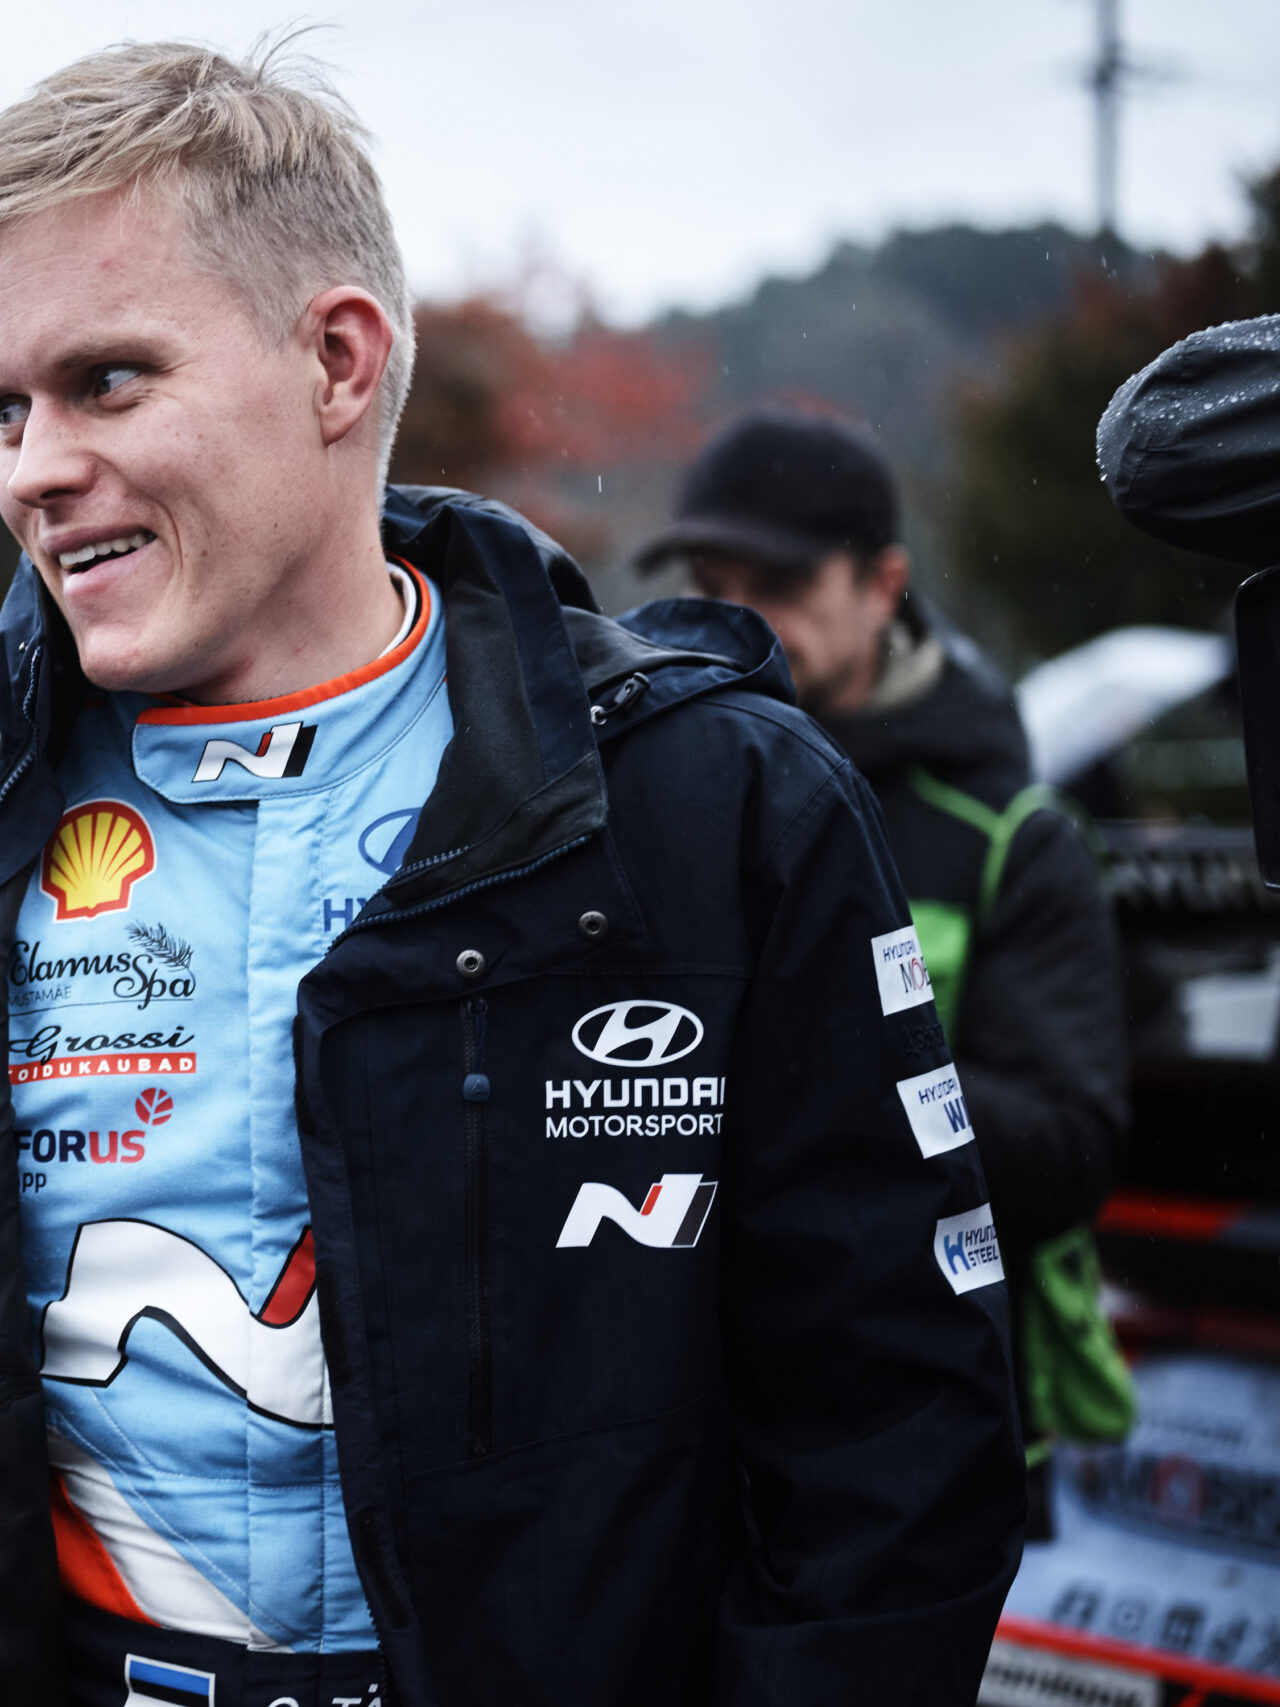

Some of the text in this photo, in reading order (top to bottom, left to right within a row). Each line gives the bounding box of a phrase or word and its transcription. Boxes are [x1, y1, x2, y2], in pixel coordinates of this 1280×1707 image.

[9, 941, 197, 1010] Elamus Spa
[9, 1025, 195, 1065] Grossi
[8, 1057, 193, 1082] OIDUKAUBAD
[545, 1076, 726, 1109] HYUNDAI
[546, 1113, 723, 1138] MOTORSPORT
[943, 1095, 972, 1134] WI
[21, 1171, 47, 1193] pp
[965, 1224, 997, 1248] HYUND
[967, 1244, 999, 1268] STEEL
